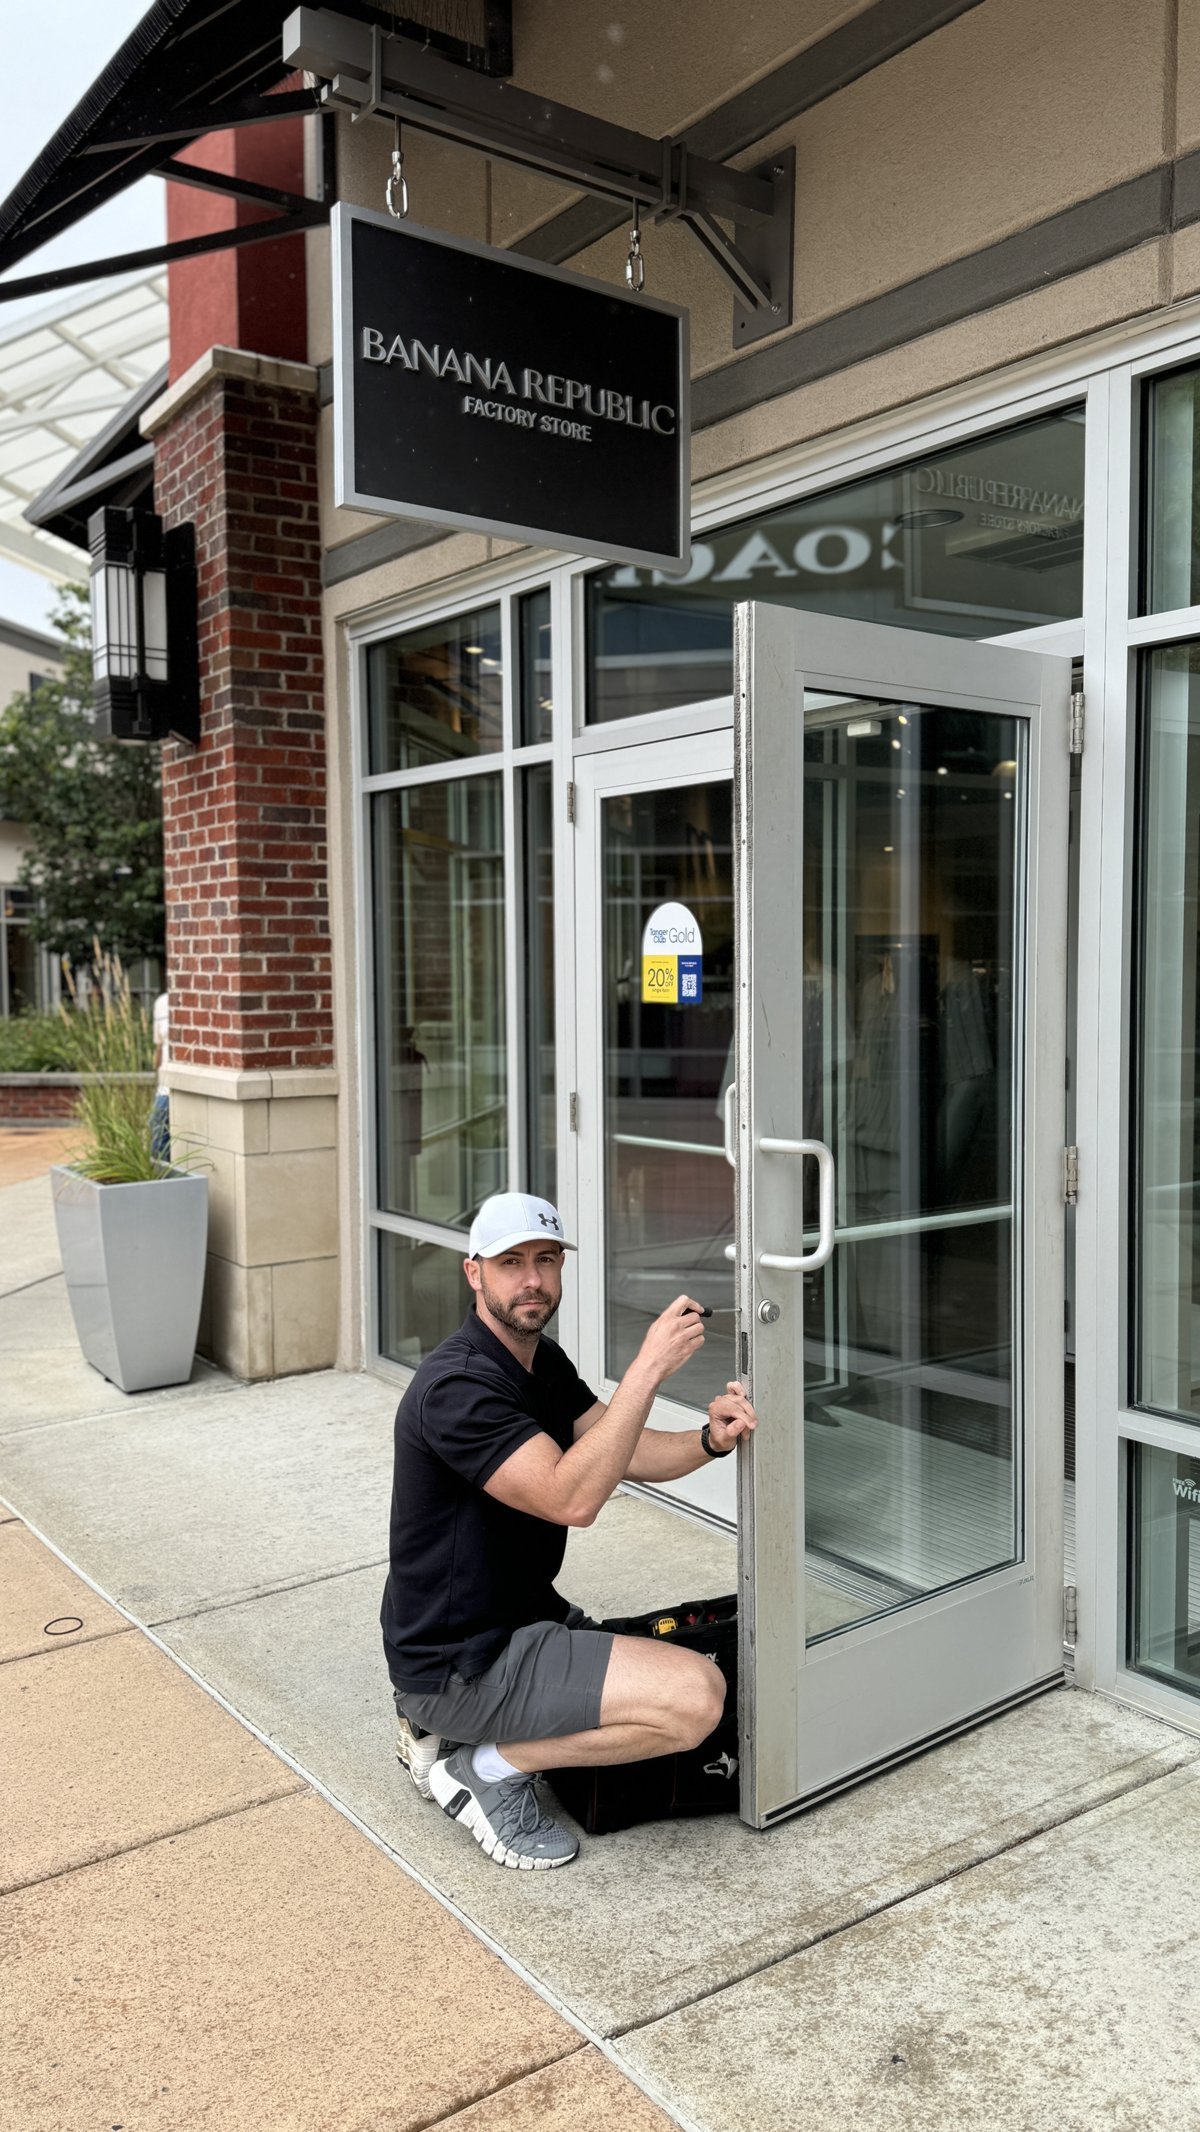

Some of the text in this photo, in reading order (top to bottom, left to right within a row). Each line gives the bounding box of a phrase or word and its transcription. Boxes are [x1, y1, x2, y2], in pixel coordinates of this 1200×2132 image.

[361, 326, 675, 435] BANANA REPUBLIC
[462, 395, 592, 442] FACTORY STORE
[669, 928, 695, 943] Gold
[648, 968, 674, 987] 20%
